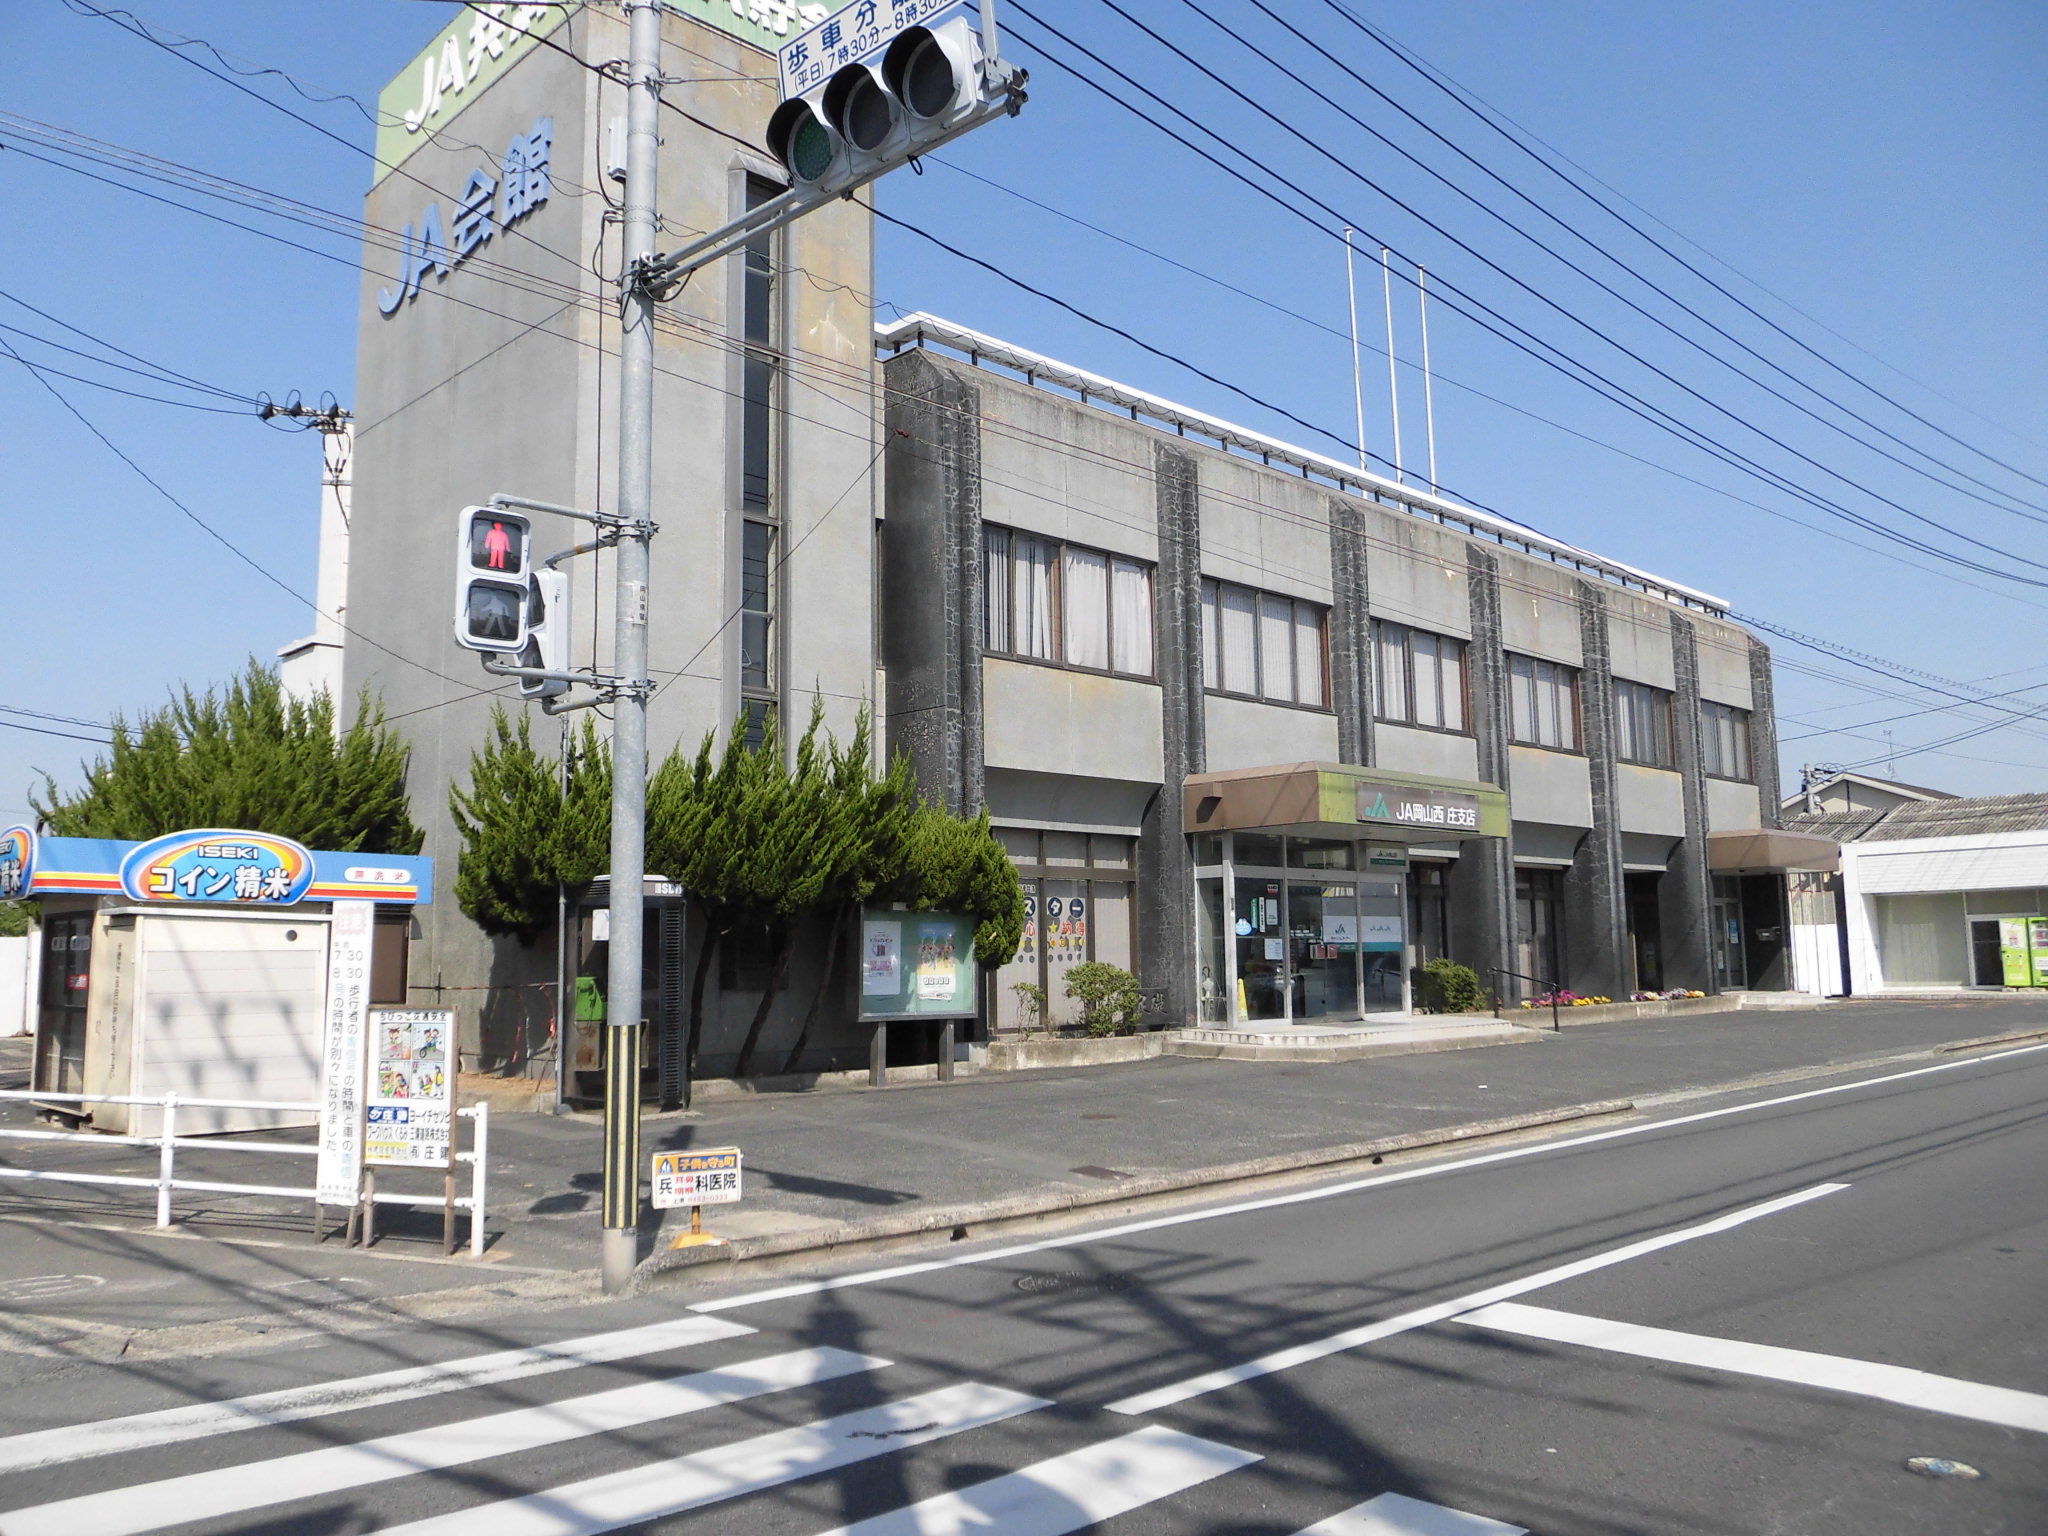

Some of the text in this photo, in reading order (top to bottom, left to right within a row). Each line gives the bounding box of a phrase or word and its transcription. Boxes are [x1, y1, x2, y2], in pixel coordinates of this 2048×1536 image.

[378, 115, 552, 314] JA会館
[1396, 802, 1476, 826] JA岡山西 庄支店
[198, 846, 259, 859] ISEKI
[149, 864, 292, 899] コイン精米
[346, 950, 364, 961] 30
[346, 967, 363, 979] 30
